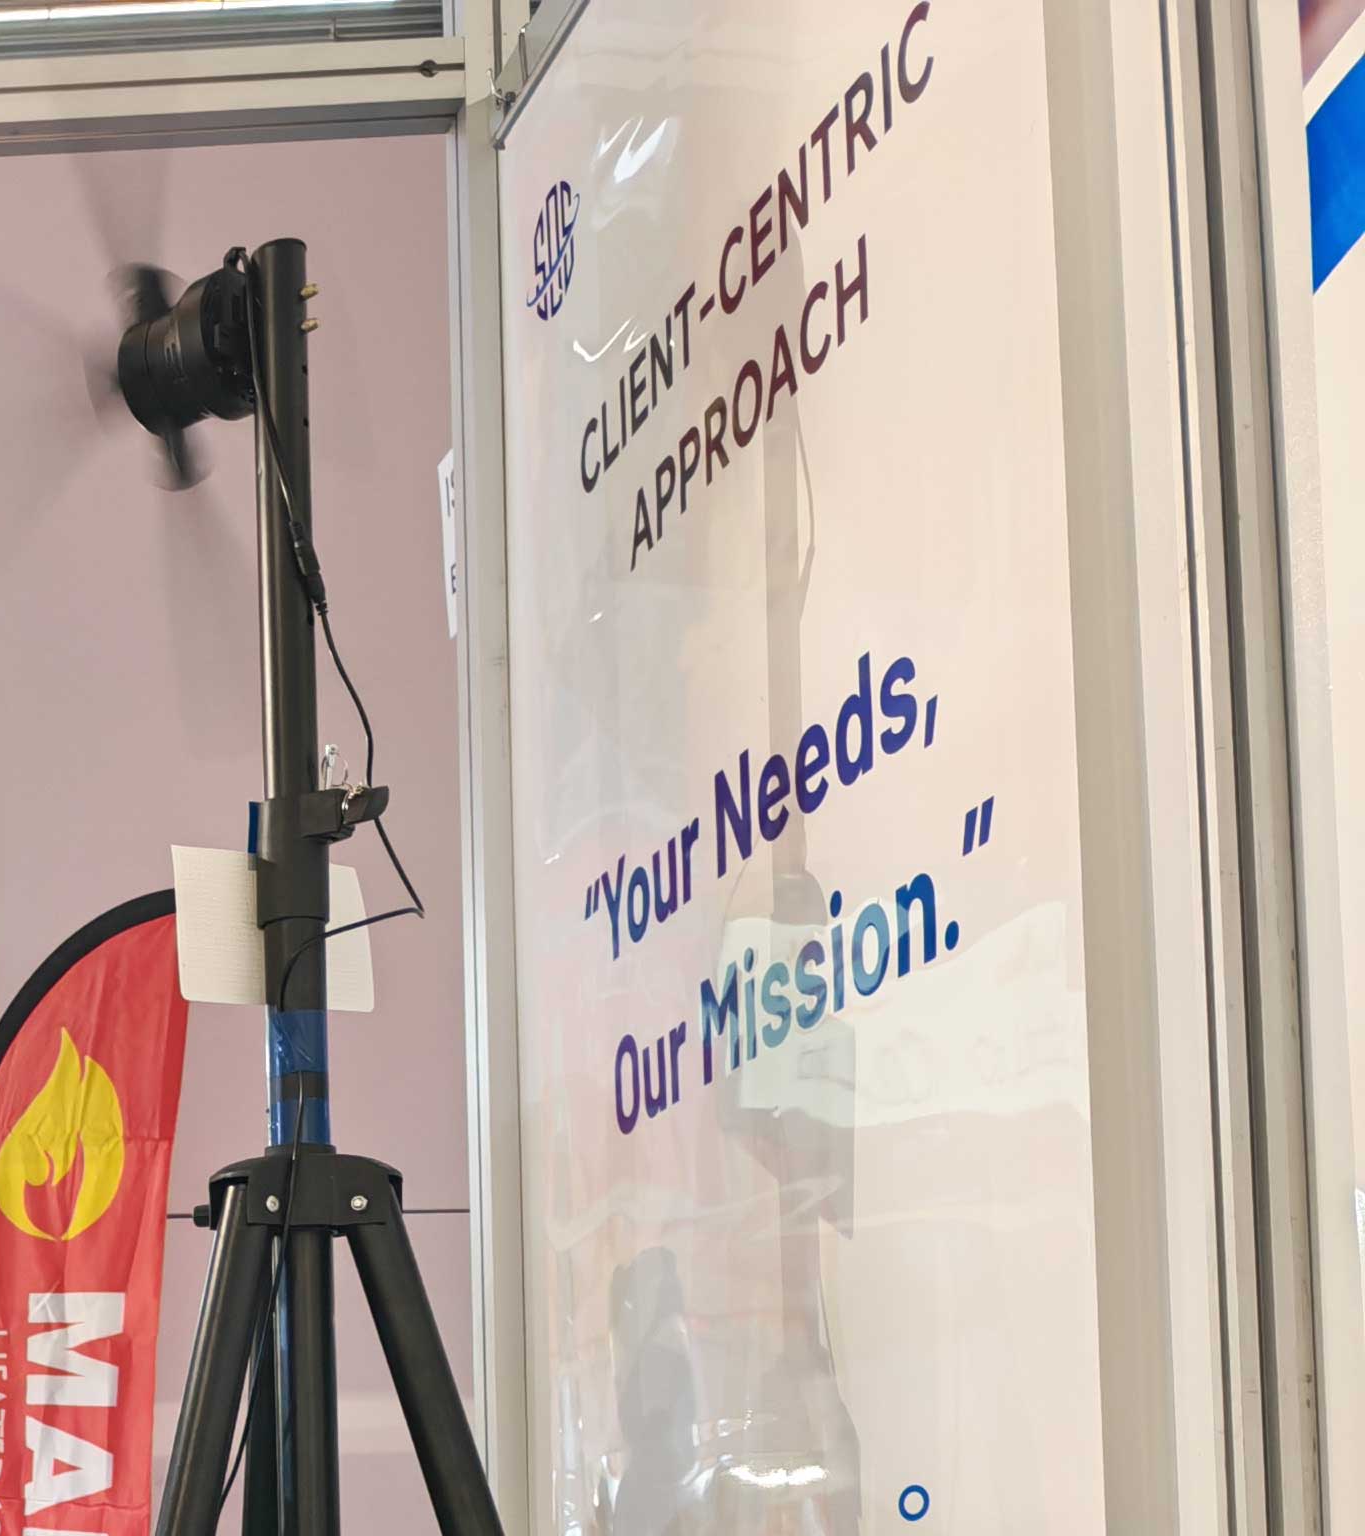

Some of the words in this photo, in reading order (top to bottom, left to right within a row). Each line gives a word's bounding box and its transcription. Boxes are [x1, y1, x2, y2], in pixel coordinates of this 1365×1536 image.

[580, 0, 934, 493] CLIENT-CENTRIC
[630, 233, 869, 572] APPROACH
[713, 651, 938, 879] Needs,
[613, 1020, 686, 1135] Our
